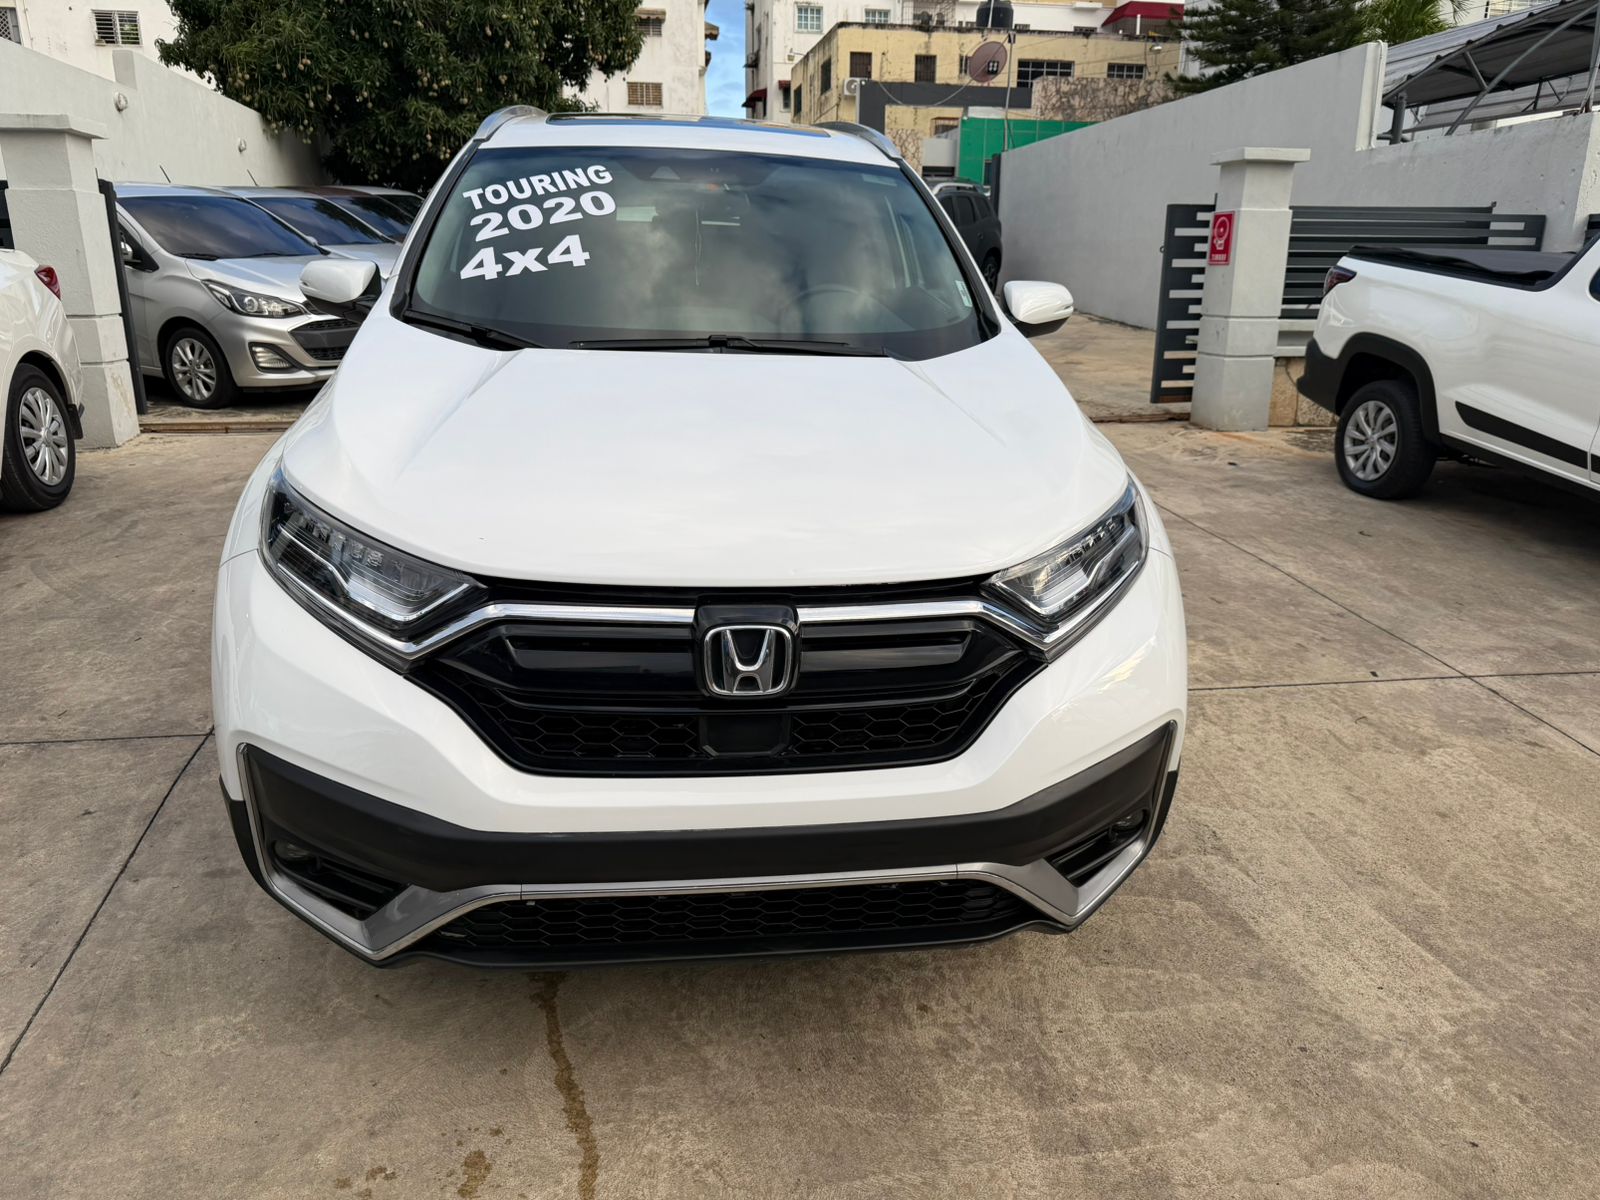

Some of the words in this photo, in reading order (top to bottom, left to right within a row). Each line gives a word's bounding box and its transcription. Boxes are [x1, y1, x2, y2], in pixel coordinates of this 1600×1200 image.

[462, 165, 613, 210] TOURING
[469, 190, 616, 242] 2020
[459, 234, 591, 281] 4x4
[719, 627, 778, 694] H
